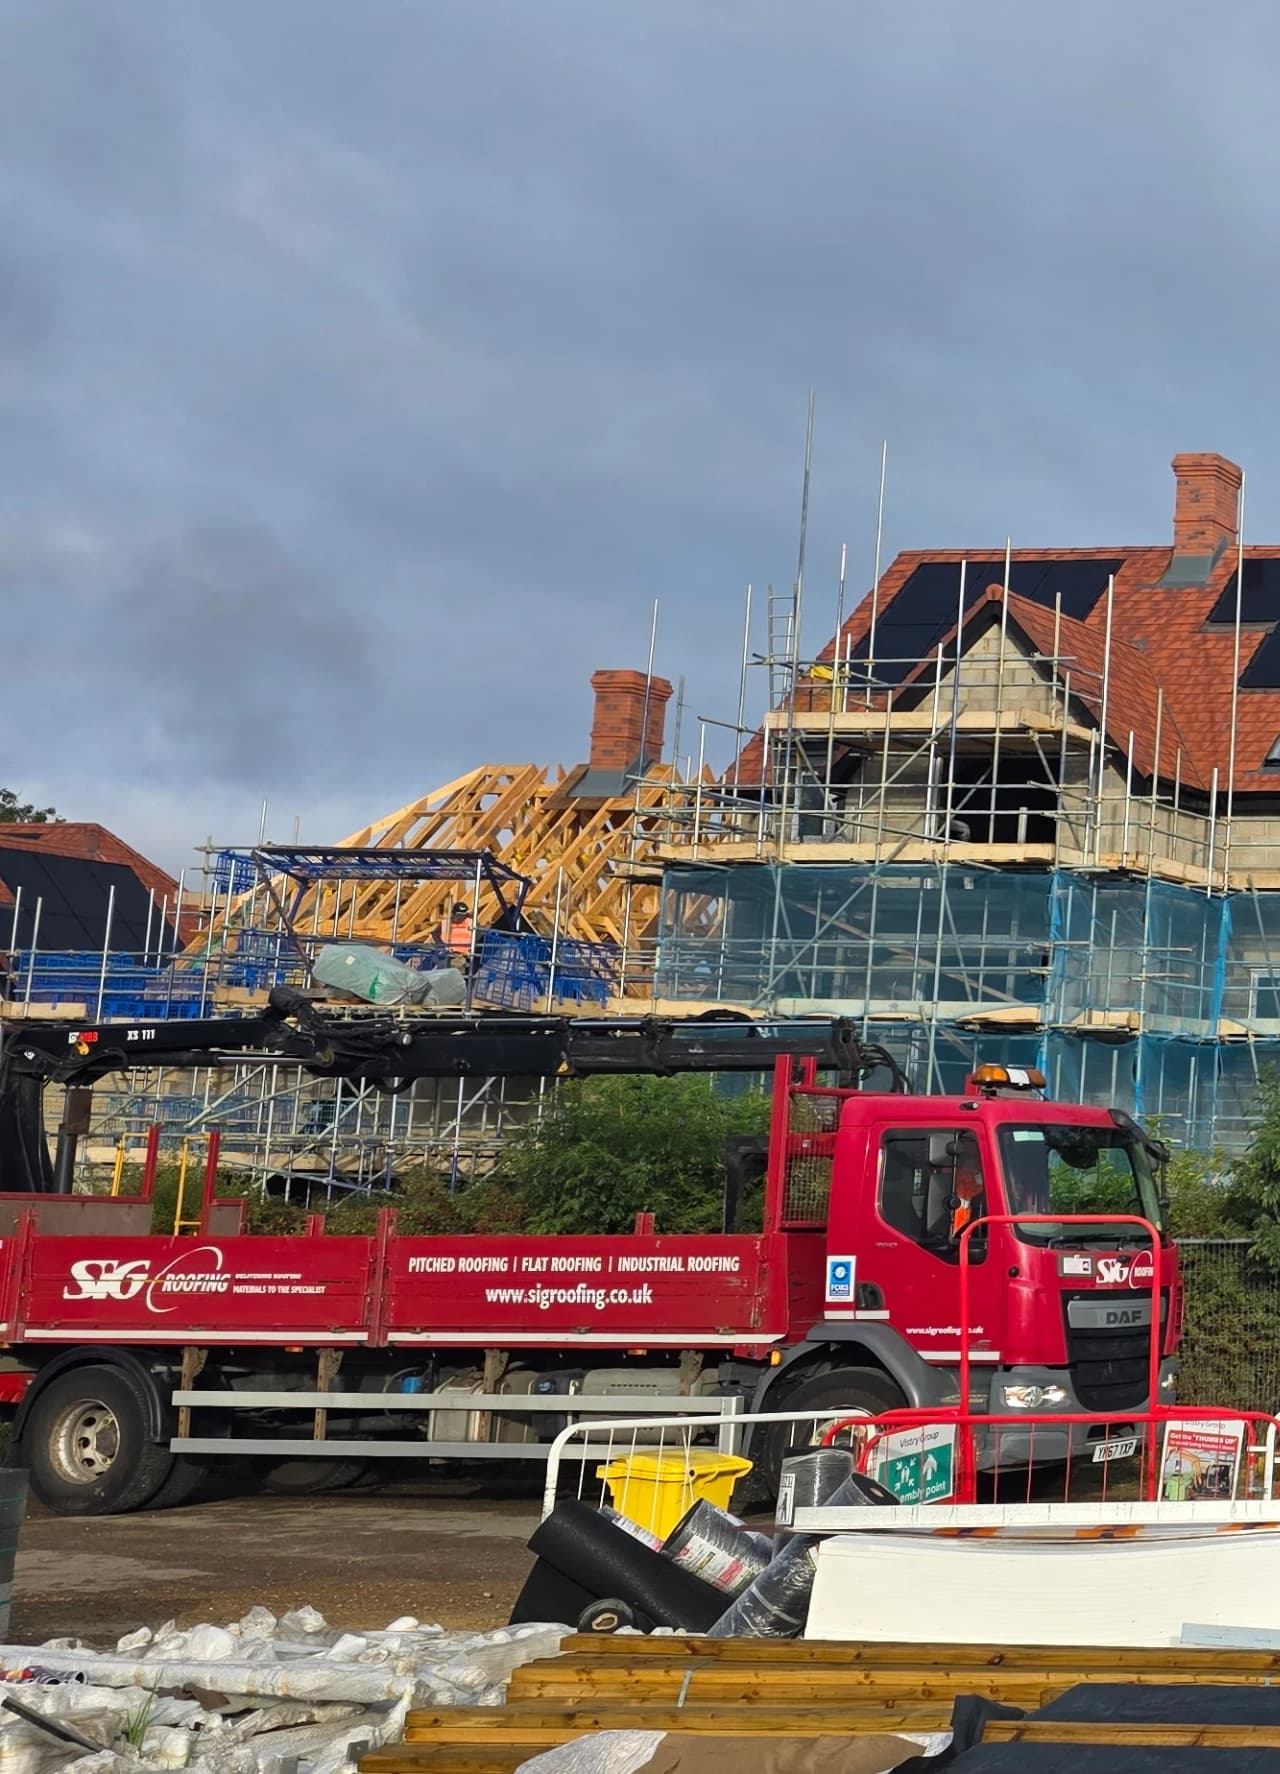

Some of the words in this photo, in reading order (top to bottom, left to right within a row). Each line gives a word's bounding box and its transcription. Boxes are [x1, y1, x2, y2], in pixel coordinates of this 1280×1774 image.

[408, 1256, 456, 1273] PITCHED
[458, 1256, 508, 1272] ROOFING
[521, 1256, 549, 1272] FLAT
[550, 1256, 602, 1272] ROOFING
[617, 1256, 685, 1272] INDUSTRIAL
[687, 1256, 740, 1272] ROOFING
[1134, 1266, 1154, 1277] ROOFIN
[63, 1259, 151, 1300] SIG
[162, 1273, 231, 1292] ROOFING
[233, 1285, 267, 1294] MATERIALS
[267, 1285, 277, 1294] TO
[277, 1285, 290, 1294] THE
[290, 1285, 326, 1294] SPECIALIST
[485, 1282, 653, 1310] www.sigroofing.co.uk
[1106, 1310, 1142, 1325] DAF
[900, 1437, 919, 1448] Vistry
[925, 1480, 946, 1498] point
